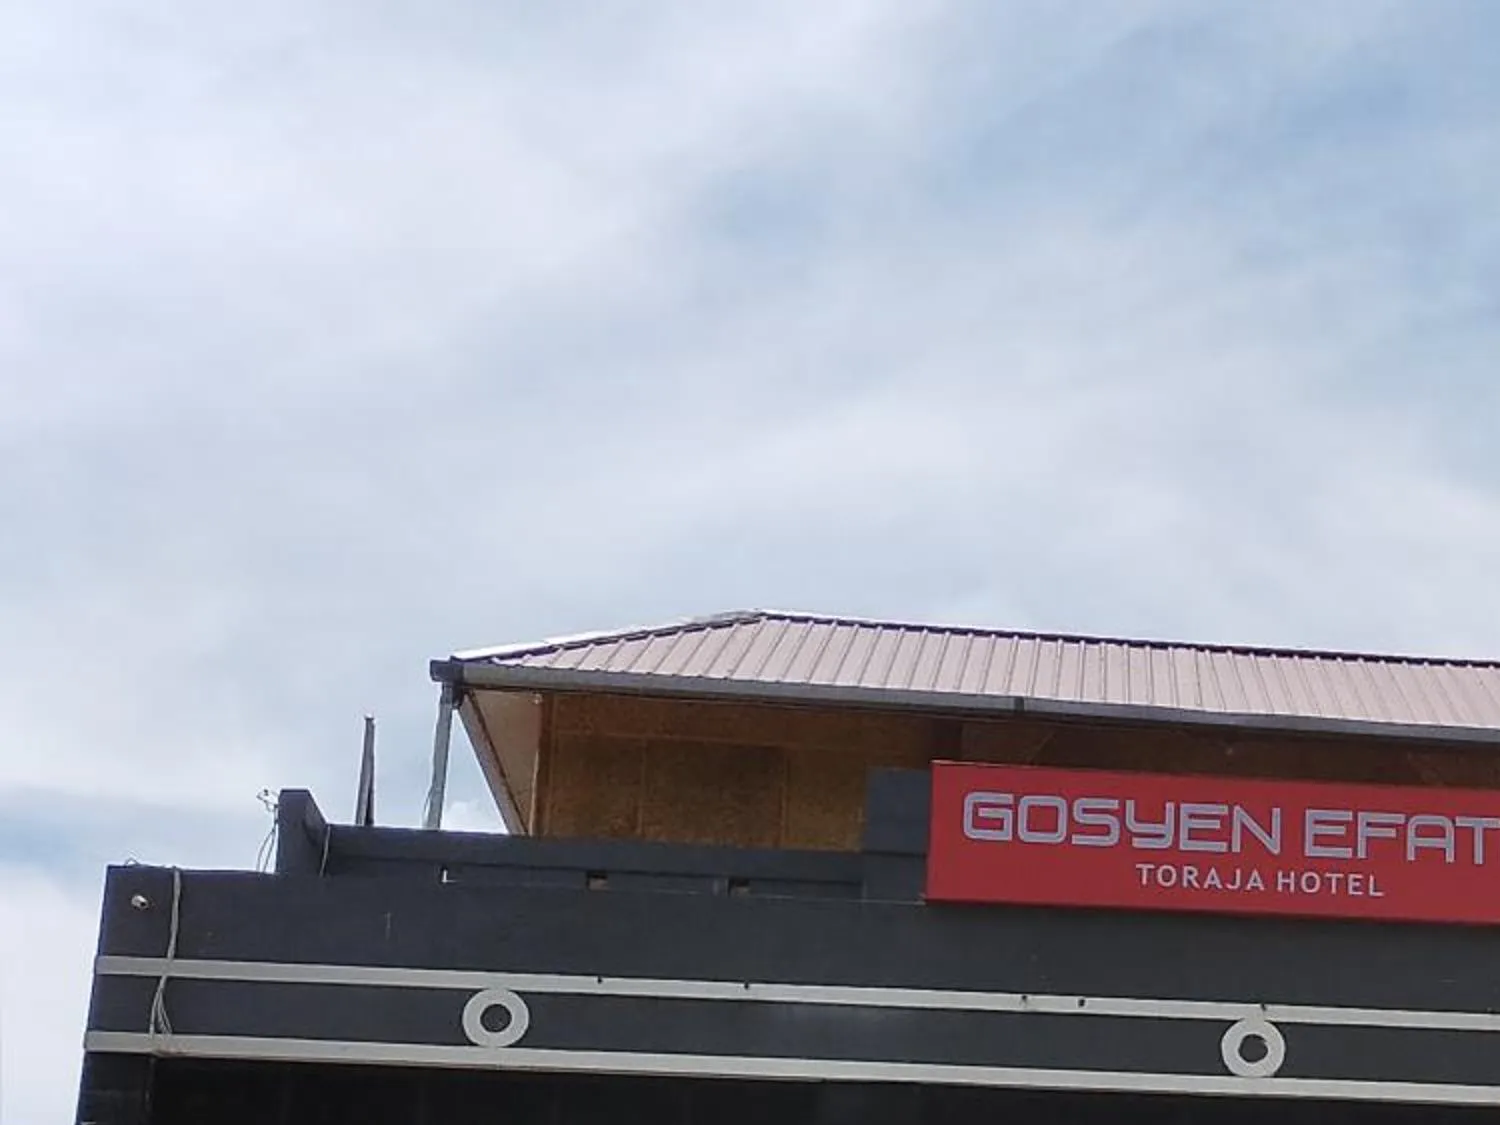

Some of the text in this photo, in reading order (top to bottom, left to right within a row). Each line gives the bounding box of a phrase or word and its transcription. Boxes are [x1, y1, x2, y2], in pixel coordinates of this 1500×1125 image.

[963, 791, 1281, 855] GOSYEN
[1136, 863, 1385, 897] TORAJA HOTEL
